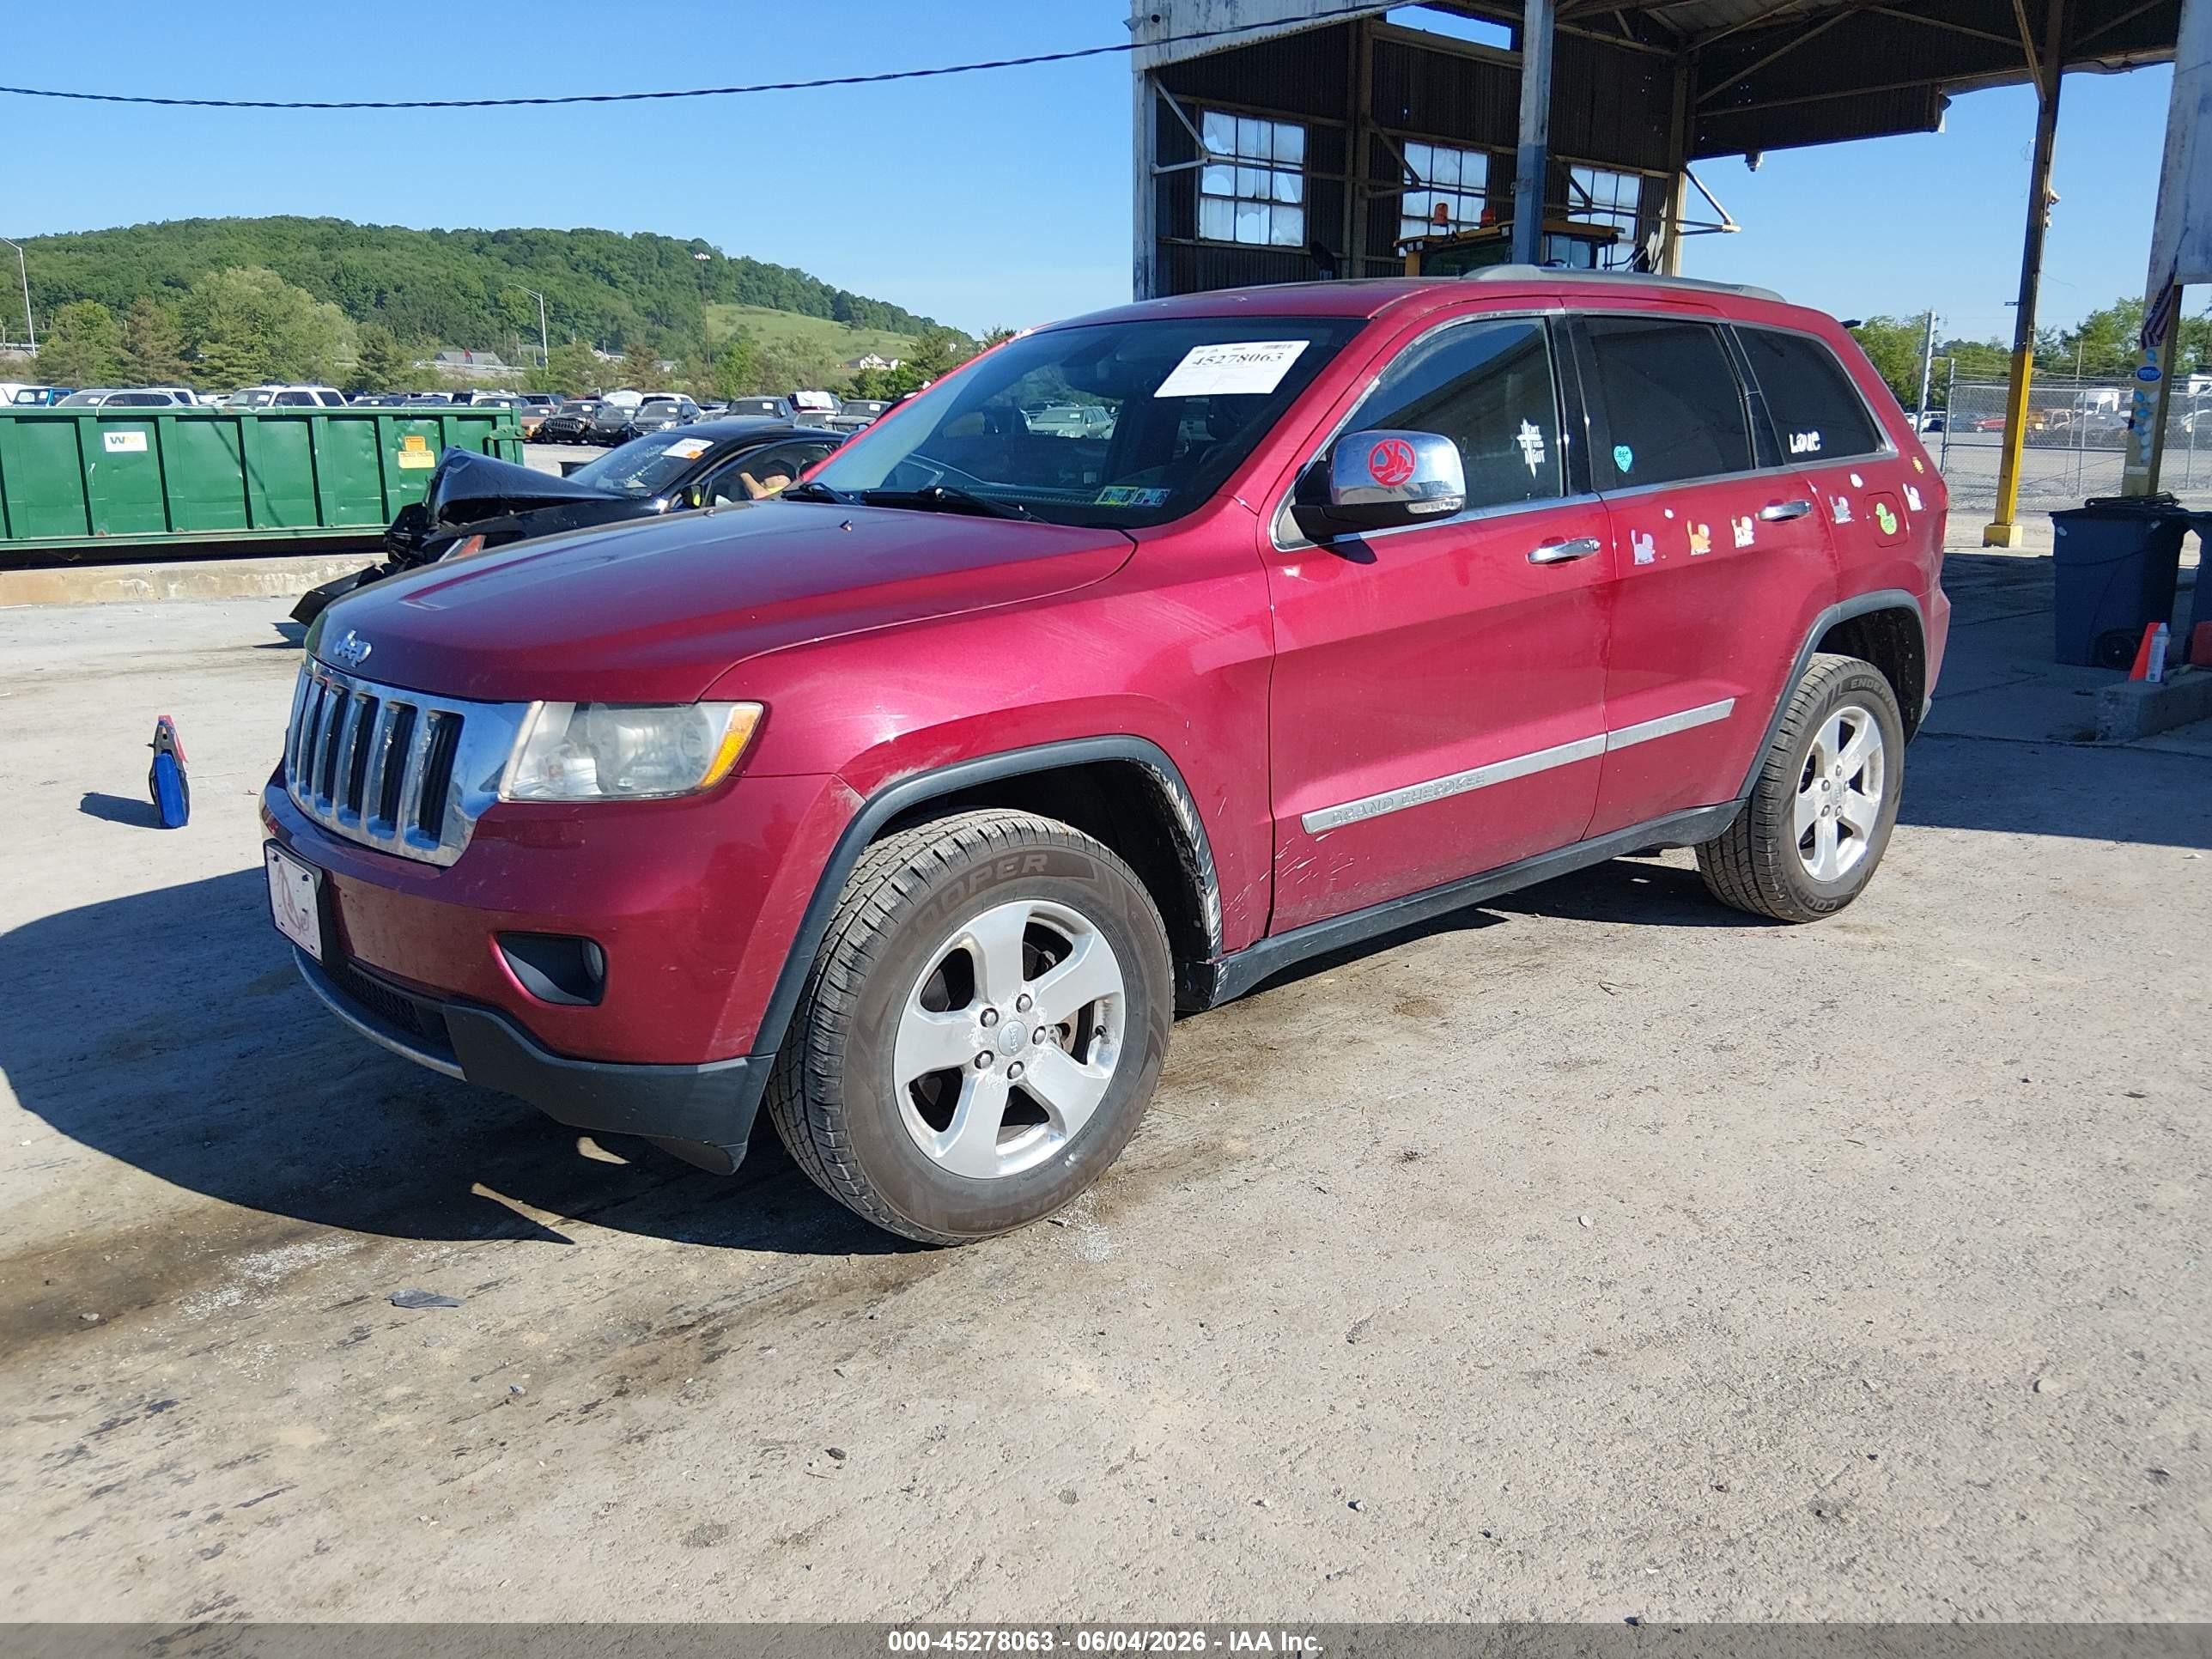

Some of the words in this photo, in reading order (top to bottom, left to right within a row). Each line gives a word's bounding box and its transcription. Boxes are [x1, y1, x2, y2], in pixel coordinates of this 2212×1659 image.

[1192, 353, 1284, 366] 45278063
[334, 629, 372, 668] Jeep
[1333, 797, 1395, 824] GRAND
[1400, 771, 1485, 805] CHEROKEE
